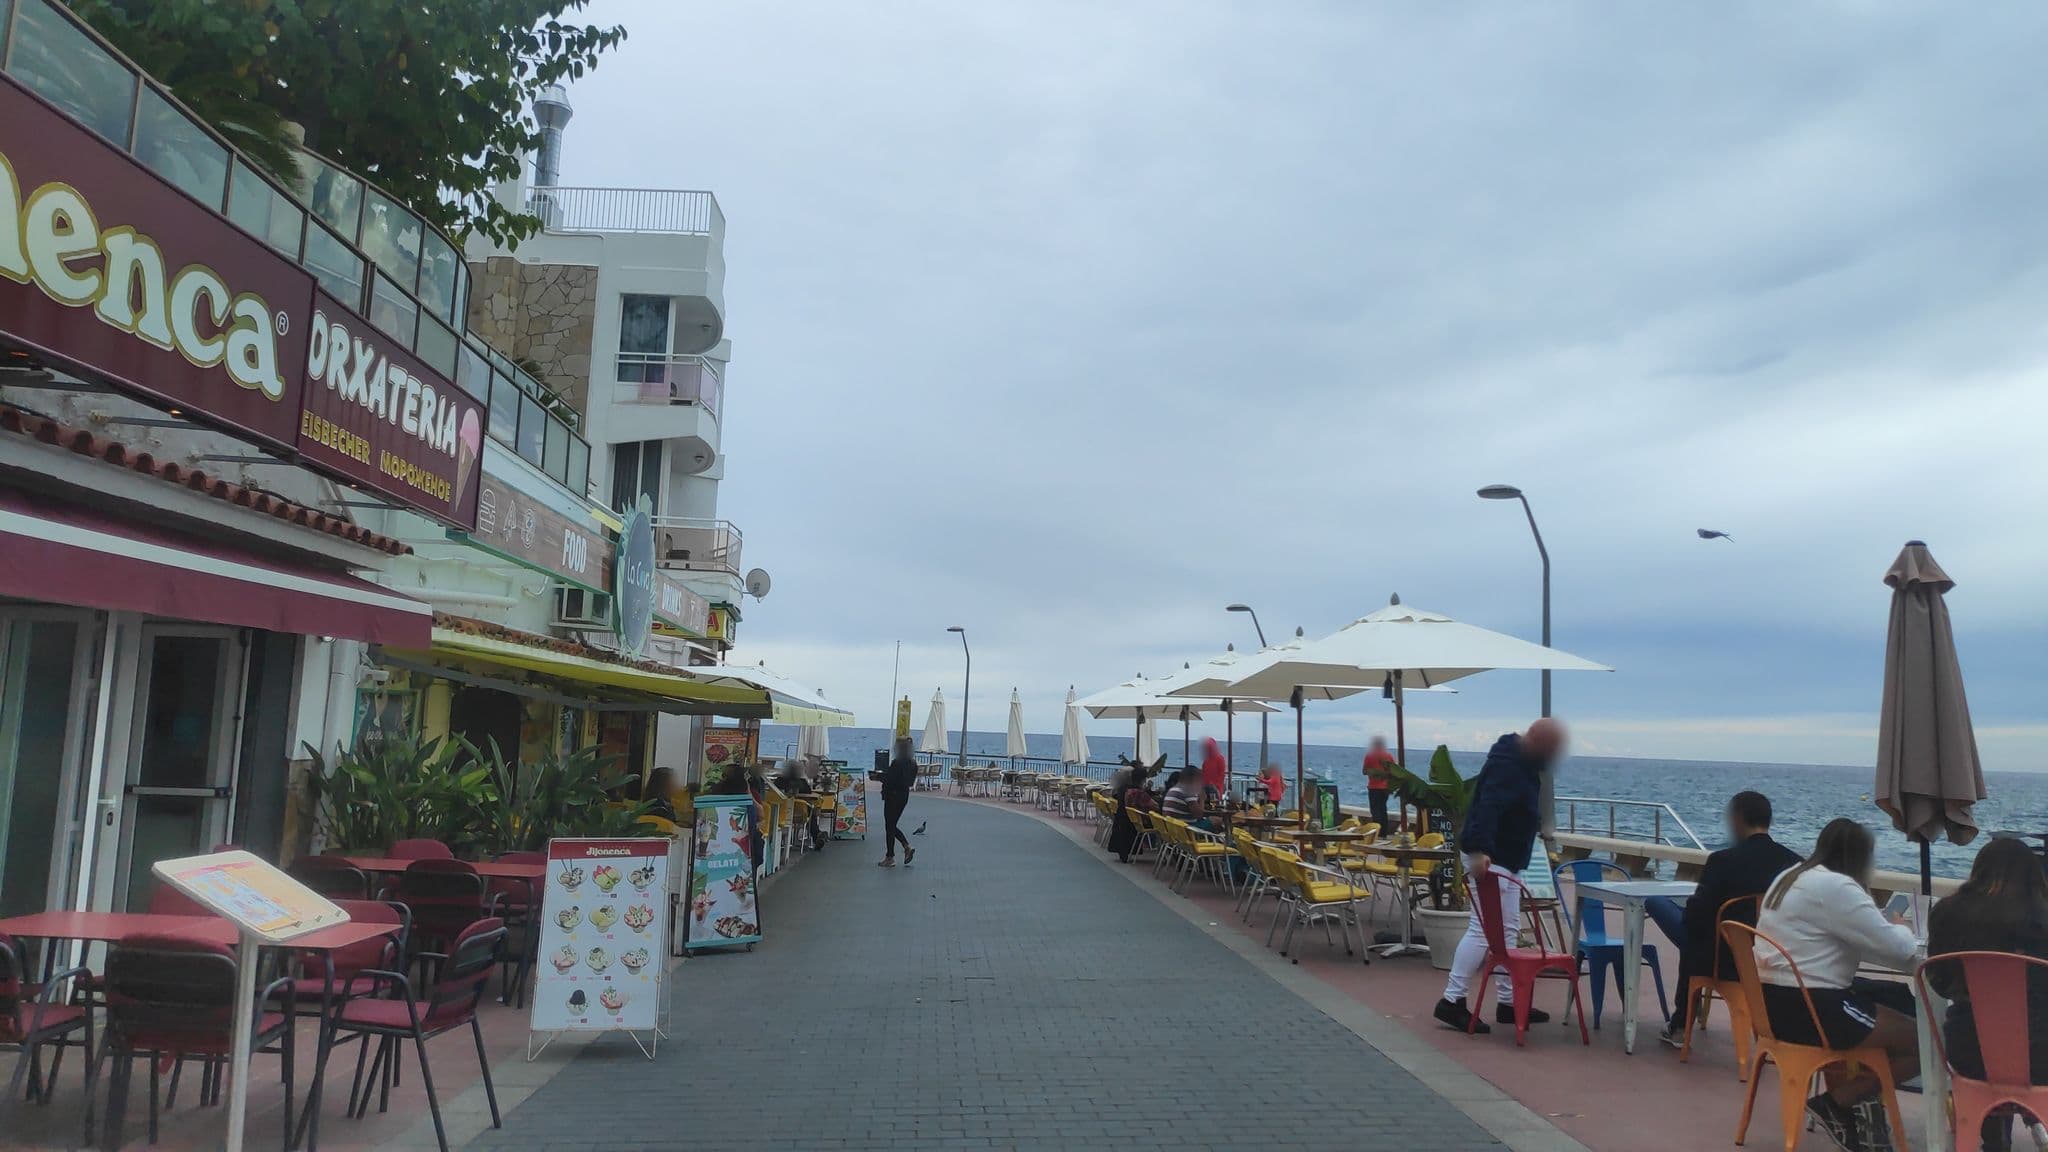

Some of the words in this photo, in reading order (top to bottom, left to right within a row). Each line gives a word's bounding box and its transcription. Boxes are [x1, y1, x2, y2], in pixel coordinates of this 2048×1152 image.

[308, 309, 457, 458] ORXATERIA
[300, 409, 371, 465] EISBECHER
[379, 449, 452, 503] МОРОЖЕНОЕ
[563, 529, 587, 574] FOOD
